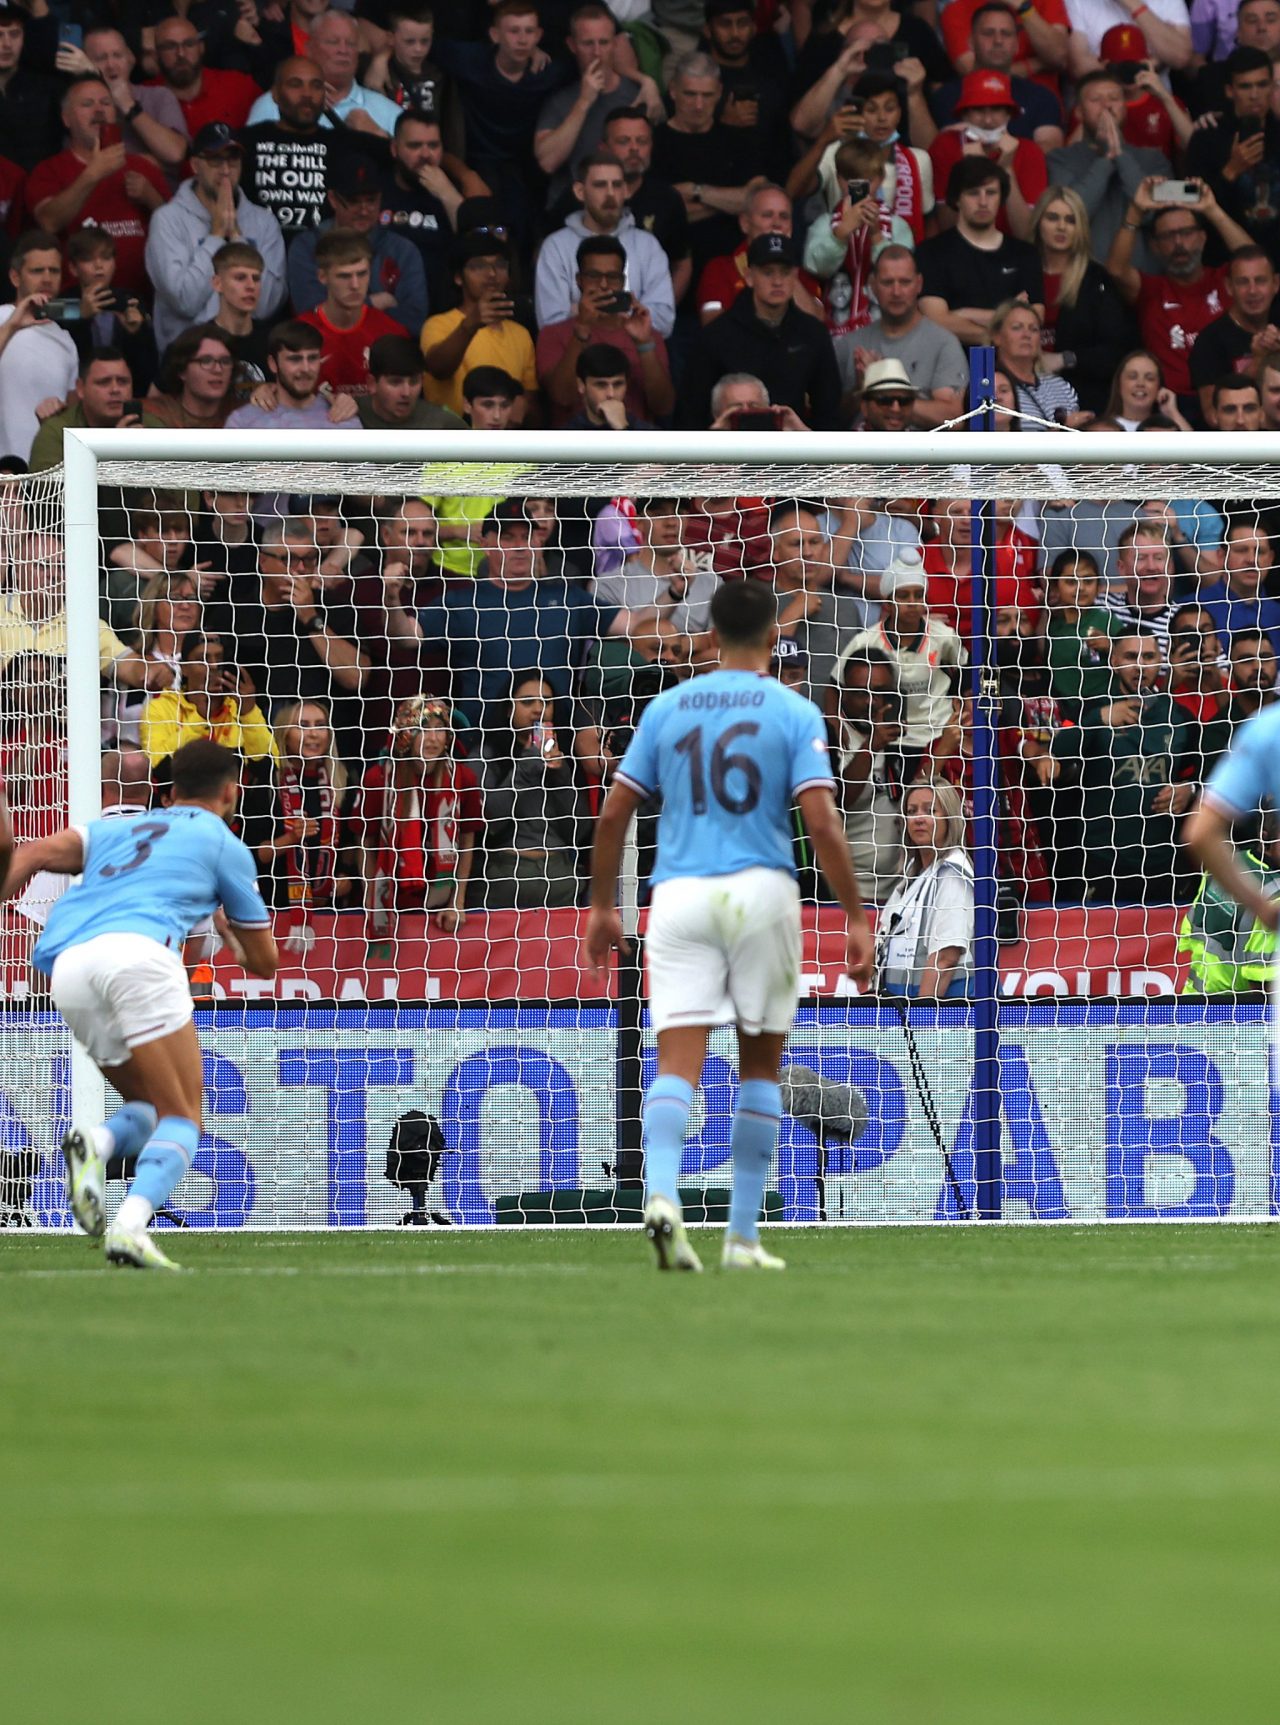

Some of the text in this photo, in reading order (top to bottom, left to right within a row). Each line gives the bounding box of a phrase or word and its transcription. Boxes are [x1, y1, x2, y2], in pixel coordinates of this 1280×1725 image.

[256, 142, 276, 152] WE
[256, 154, 327, 170] THE HILL
[255, 169, 326, 188] IN OUR
[259, 189, 326, 204] OWN WAY
[678, 690, 766, 711] RODRIGO
[674, 720, 763, 816] 16
[1112, 754, 1169, 785] AXA
[98, 821, 170, 877] 3
